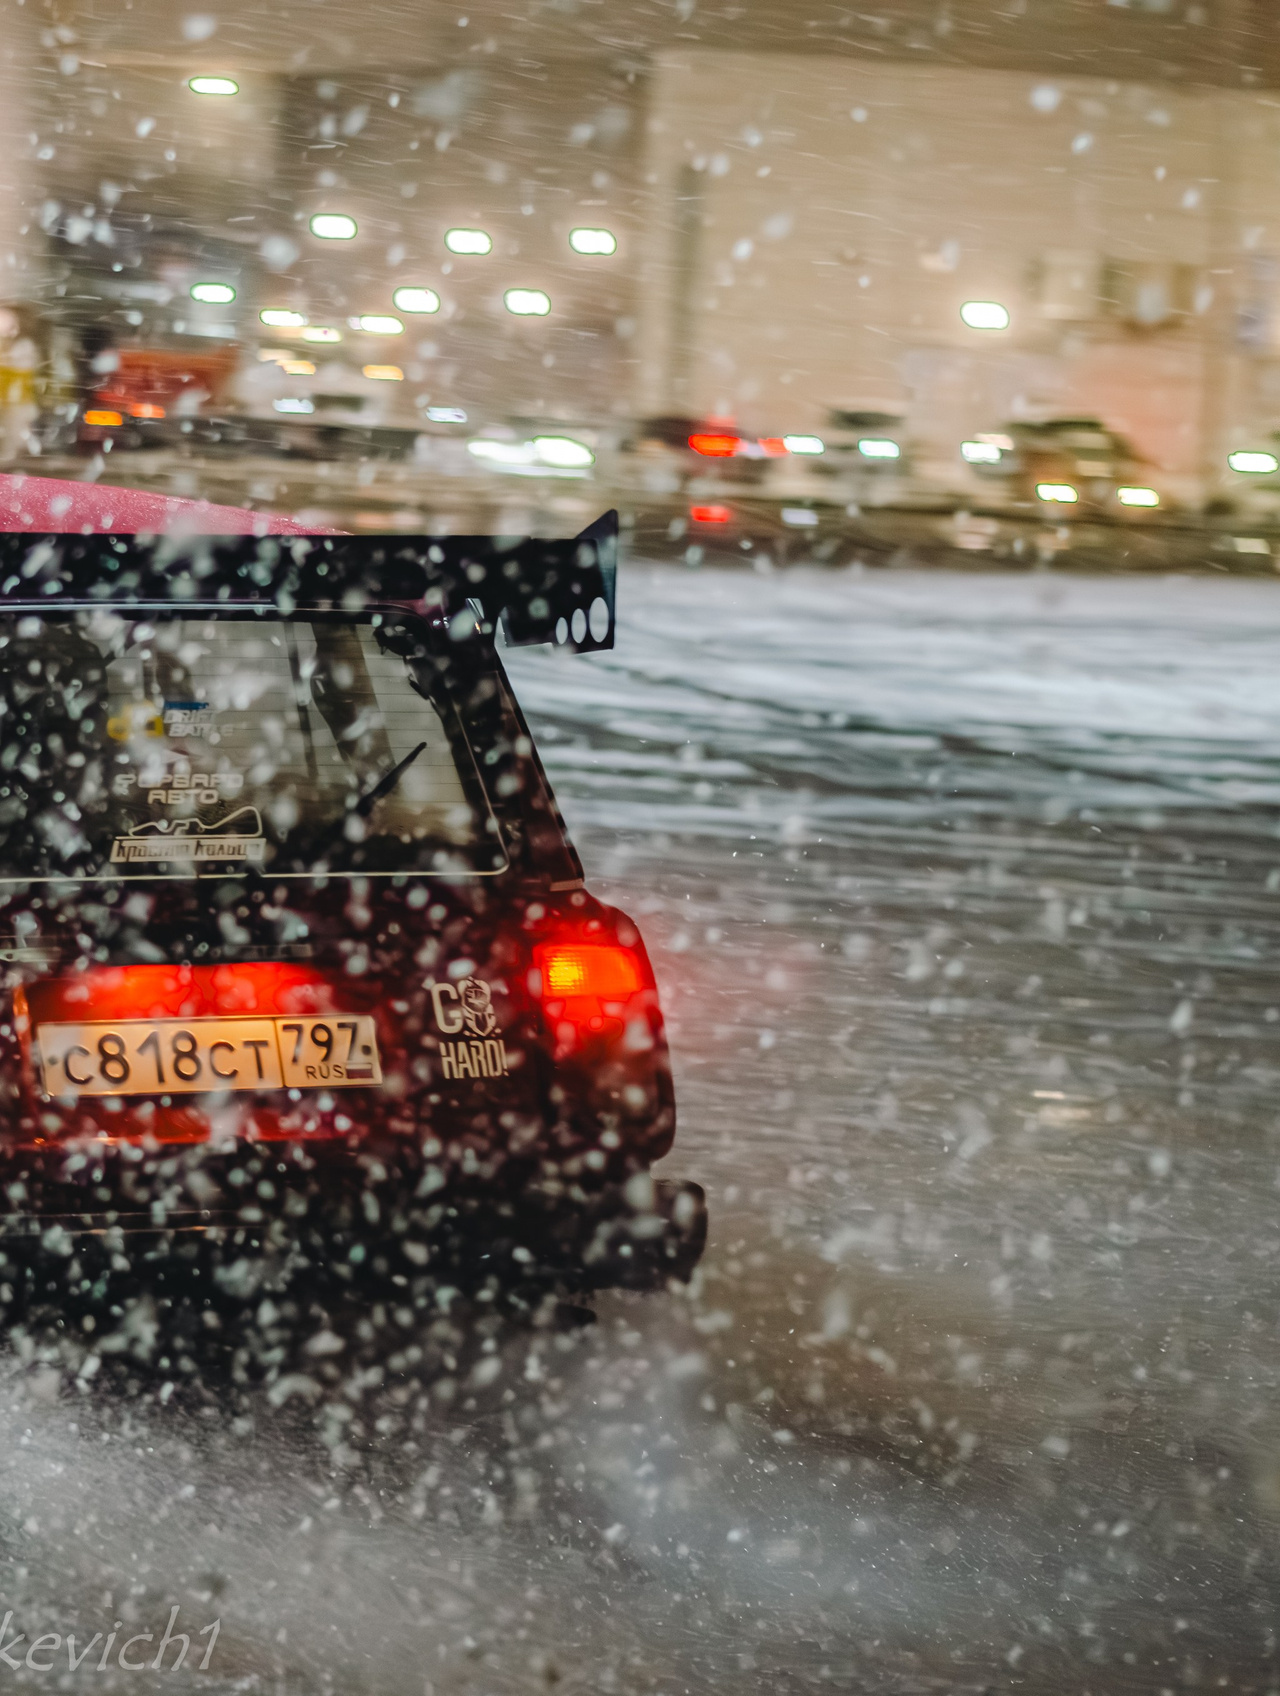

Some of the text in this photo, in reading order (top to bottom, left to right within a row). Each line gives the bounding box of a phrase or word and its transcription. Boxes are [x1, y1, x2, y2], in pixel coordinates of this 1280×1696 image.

[281, 1022, 359, 1064] 797
[438, 1038, 510, 1079] HARD!
[304, 1064, 346, 1081] RUS
